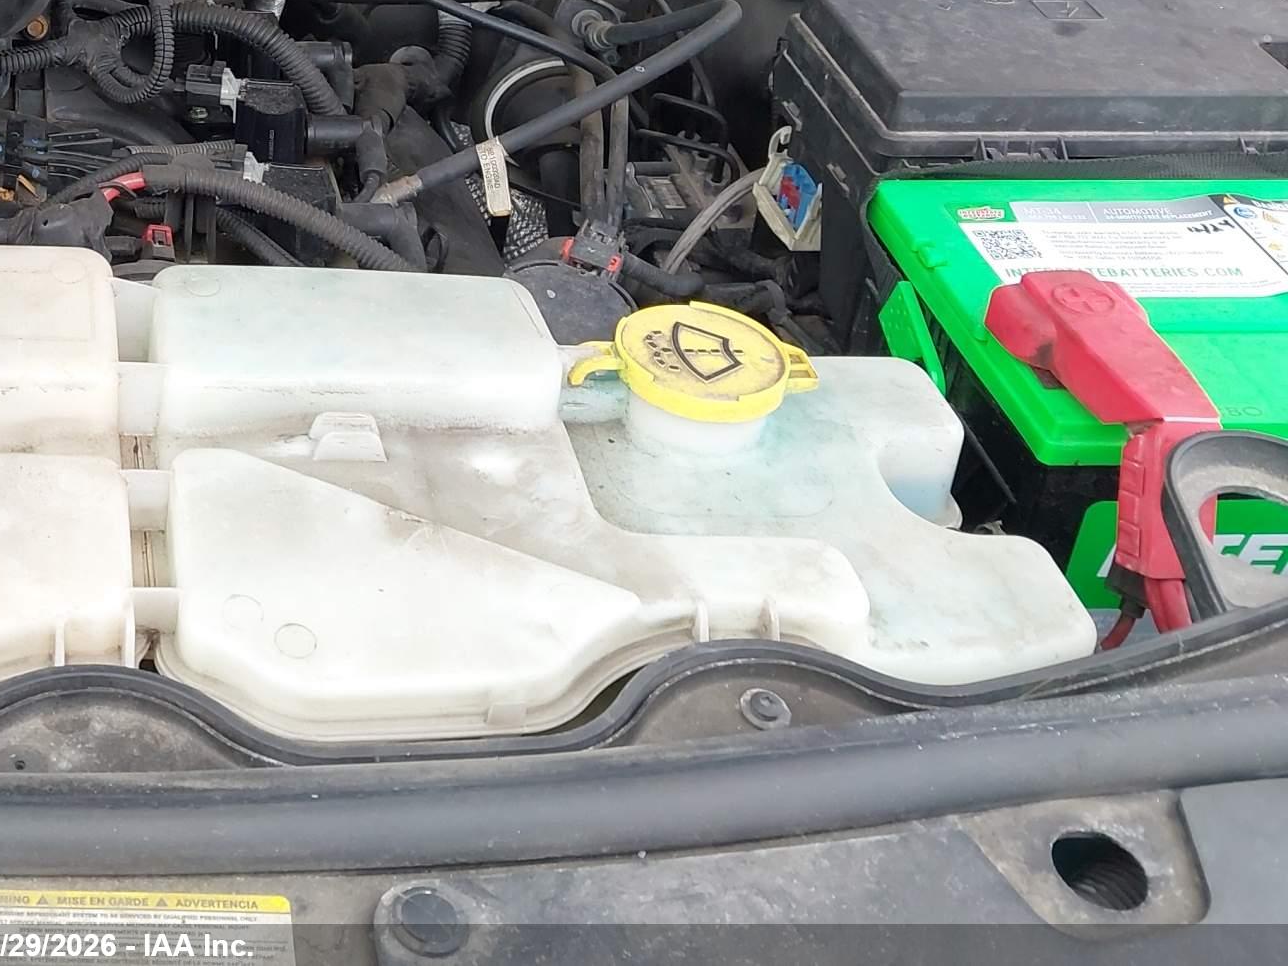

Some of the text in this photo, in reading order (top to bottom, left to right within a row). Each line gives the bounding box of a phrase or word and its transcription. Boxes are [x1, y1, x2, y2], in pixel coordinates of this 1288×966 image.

[57, 896, 86, 906] MISE
[89, 897, 105, 906] EN
[108, 897, 149, 907] GARDE
[175, 898, 258, 910] ADVERTENCIA
